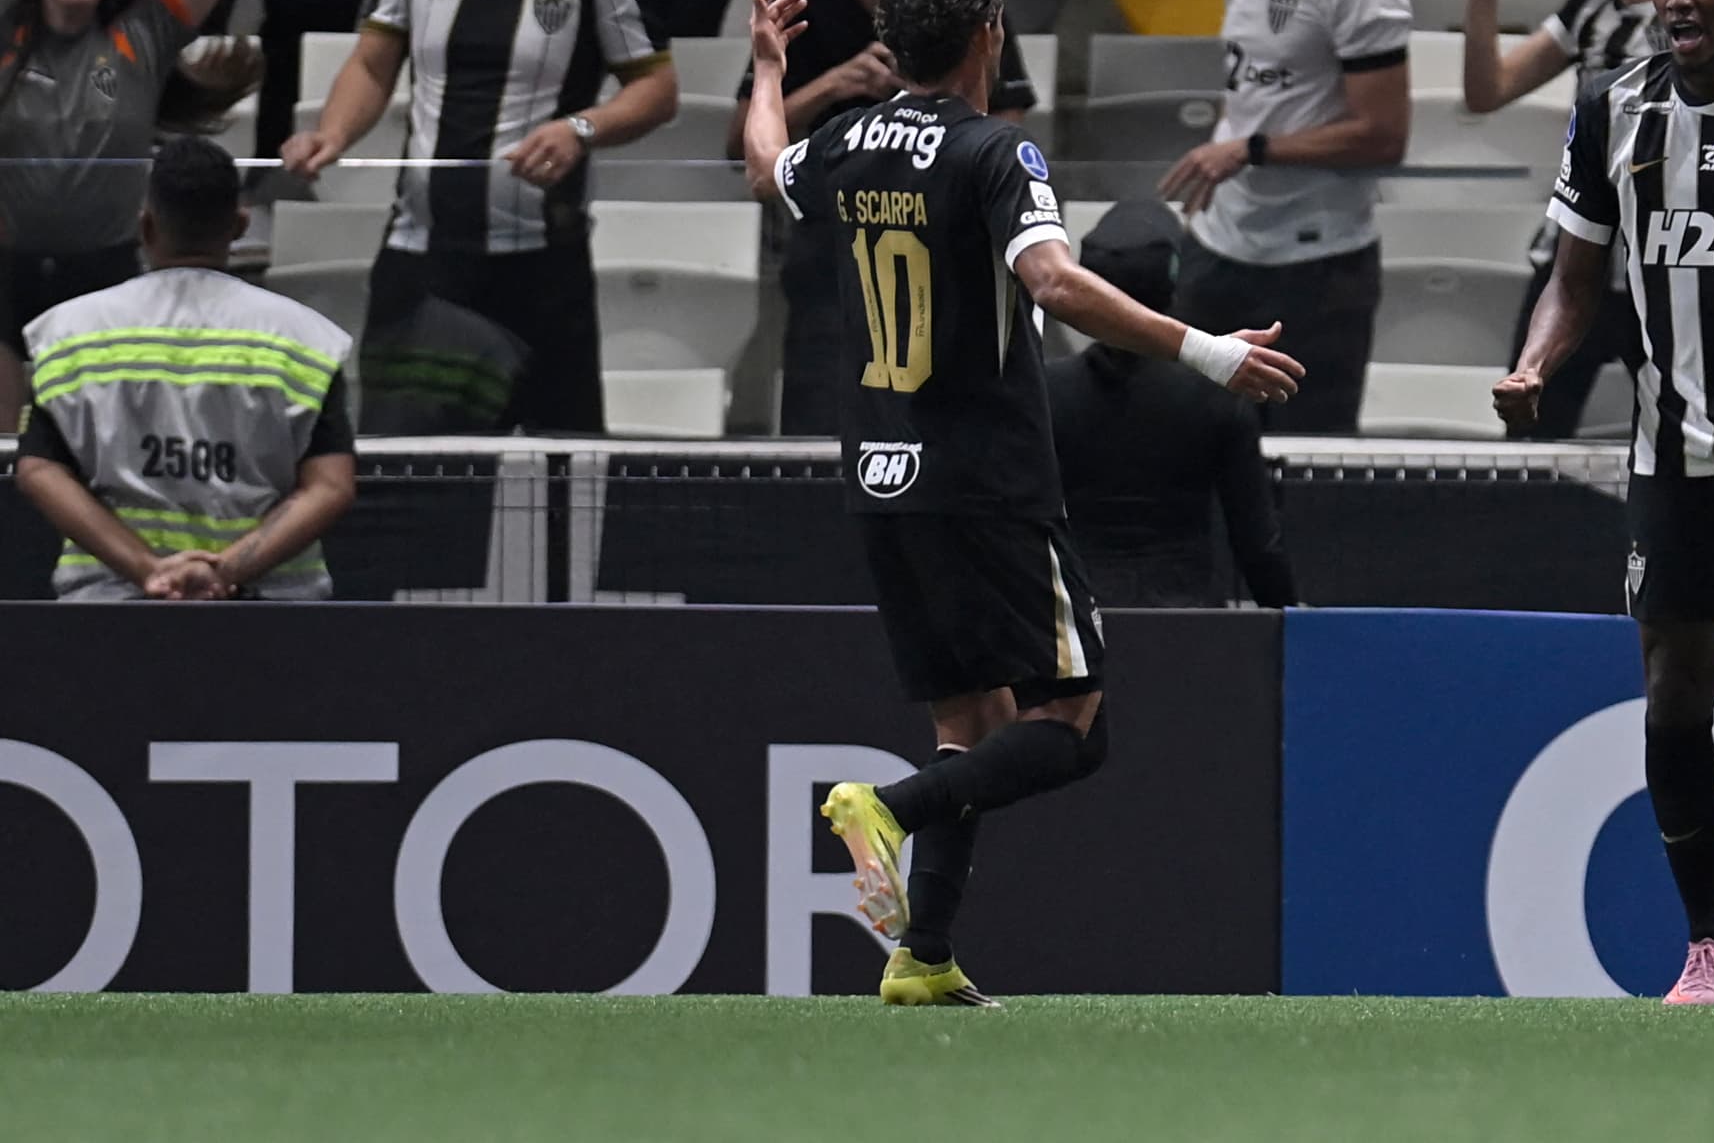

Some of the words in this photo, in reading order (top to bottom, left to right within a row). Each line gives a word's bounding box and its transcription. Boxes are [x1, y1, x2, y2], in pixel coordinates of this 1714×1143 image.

[863, 114, 947, 170] bmg
[855, 190, 928, 226] SCARPA
[851, 228, 933, 393] 10
[864, 453, 910, 487] BH
